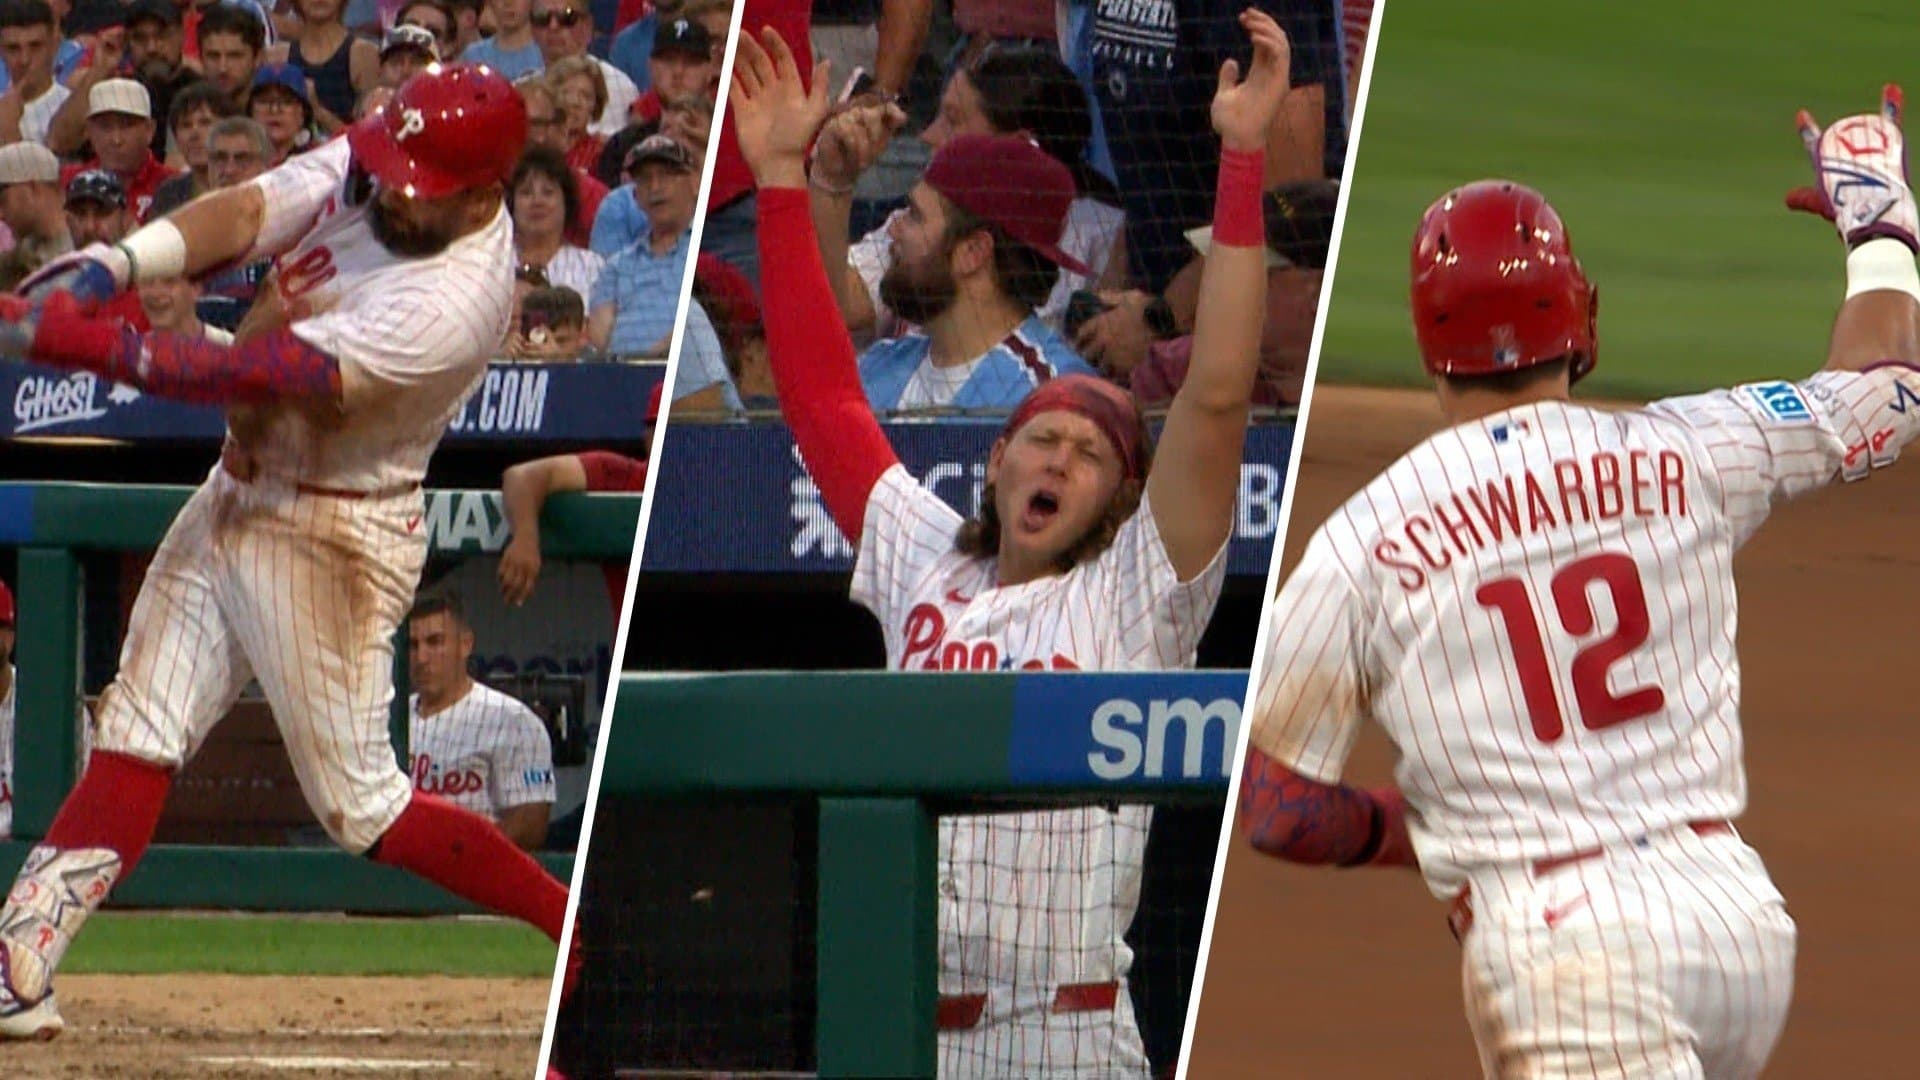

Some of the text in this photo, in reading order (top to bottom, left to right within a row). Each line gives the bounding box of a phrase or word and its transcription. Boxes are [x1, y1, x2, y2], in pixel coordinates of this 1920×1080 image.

[1374, 449, 1687, 593] SCHWARBER
[1475, 552, 1666, 745] 12
[1087, 697, 1243, 781] sm
